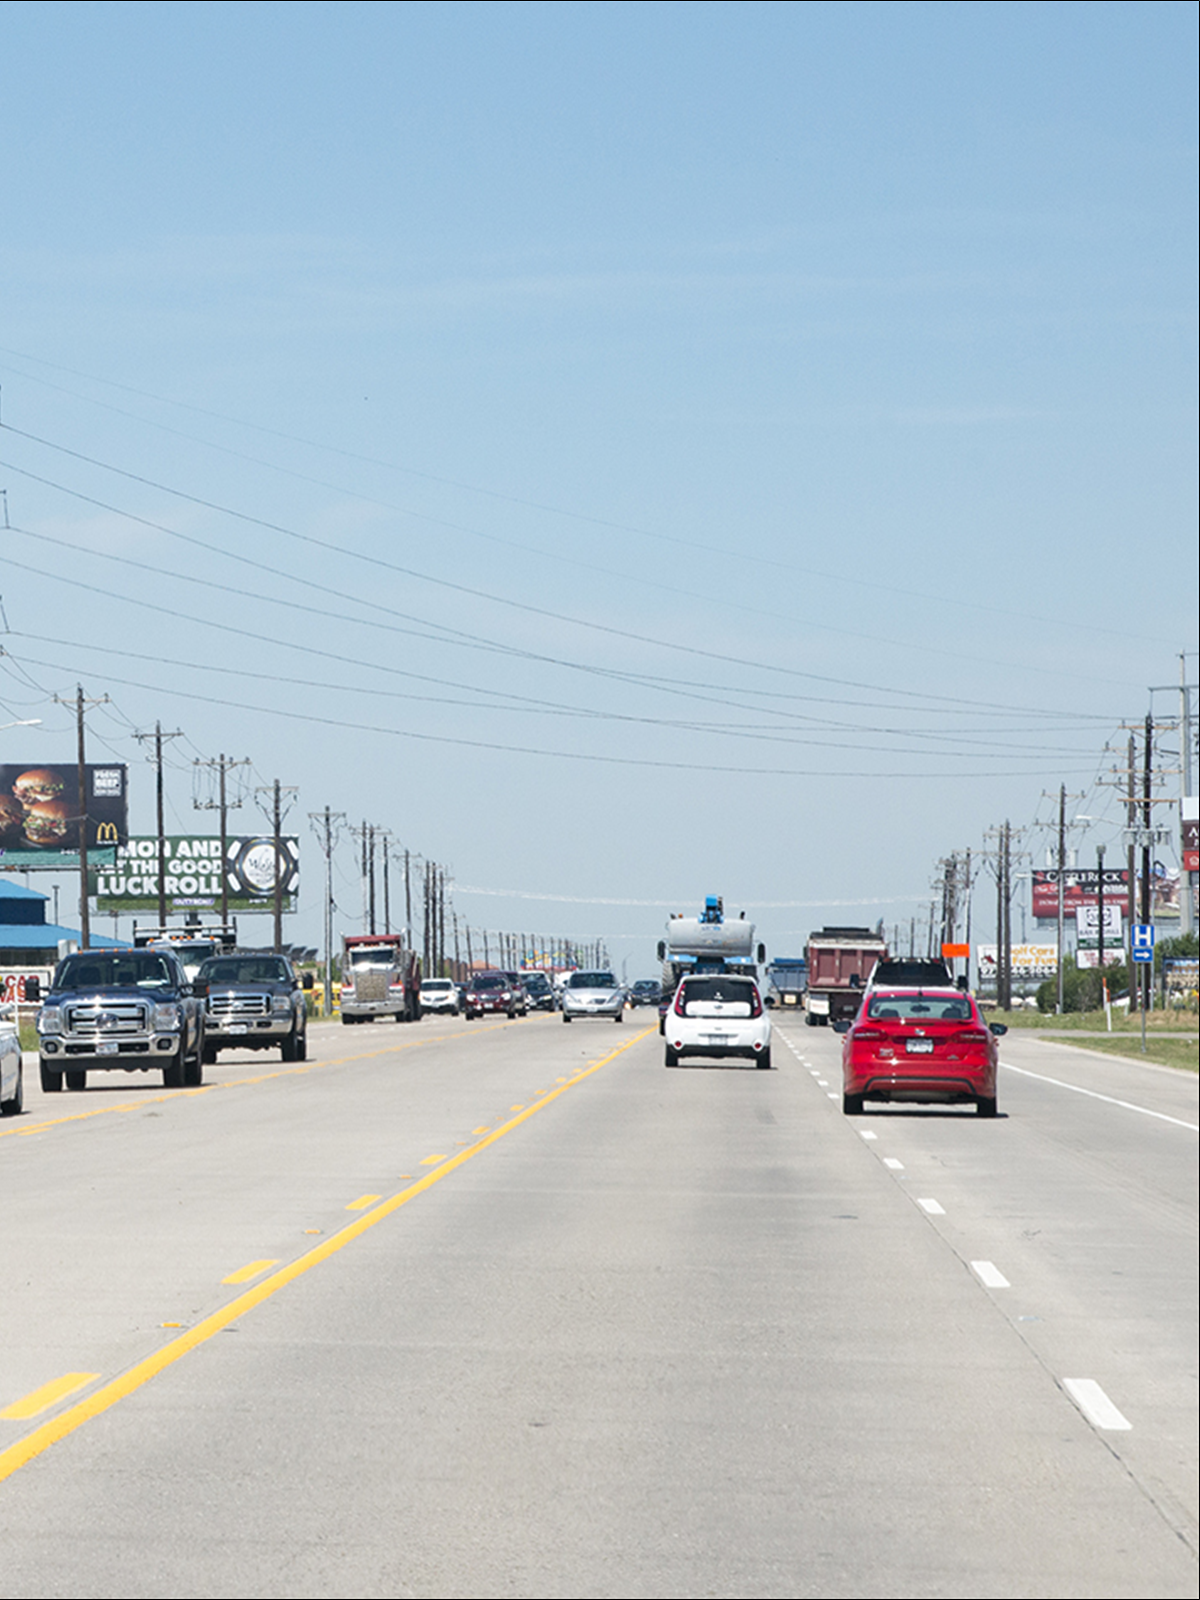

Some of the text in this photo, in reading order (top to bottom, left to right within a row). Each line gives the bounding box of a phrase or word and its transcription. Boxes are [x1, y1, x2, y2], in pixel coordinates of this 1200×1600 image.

[116, 840, 222, 858] MON AND
[167, 859, 222, 875] GOOD
[97, 876, 223, 895] LUCK ROLL
[1134, 925, 1152, 946] H
[1011, 945, 1055, 956] olf Cars
[1012, 956, 1033, 966] For
[5, 975, 40, 988] CA
